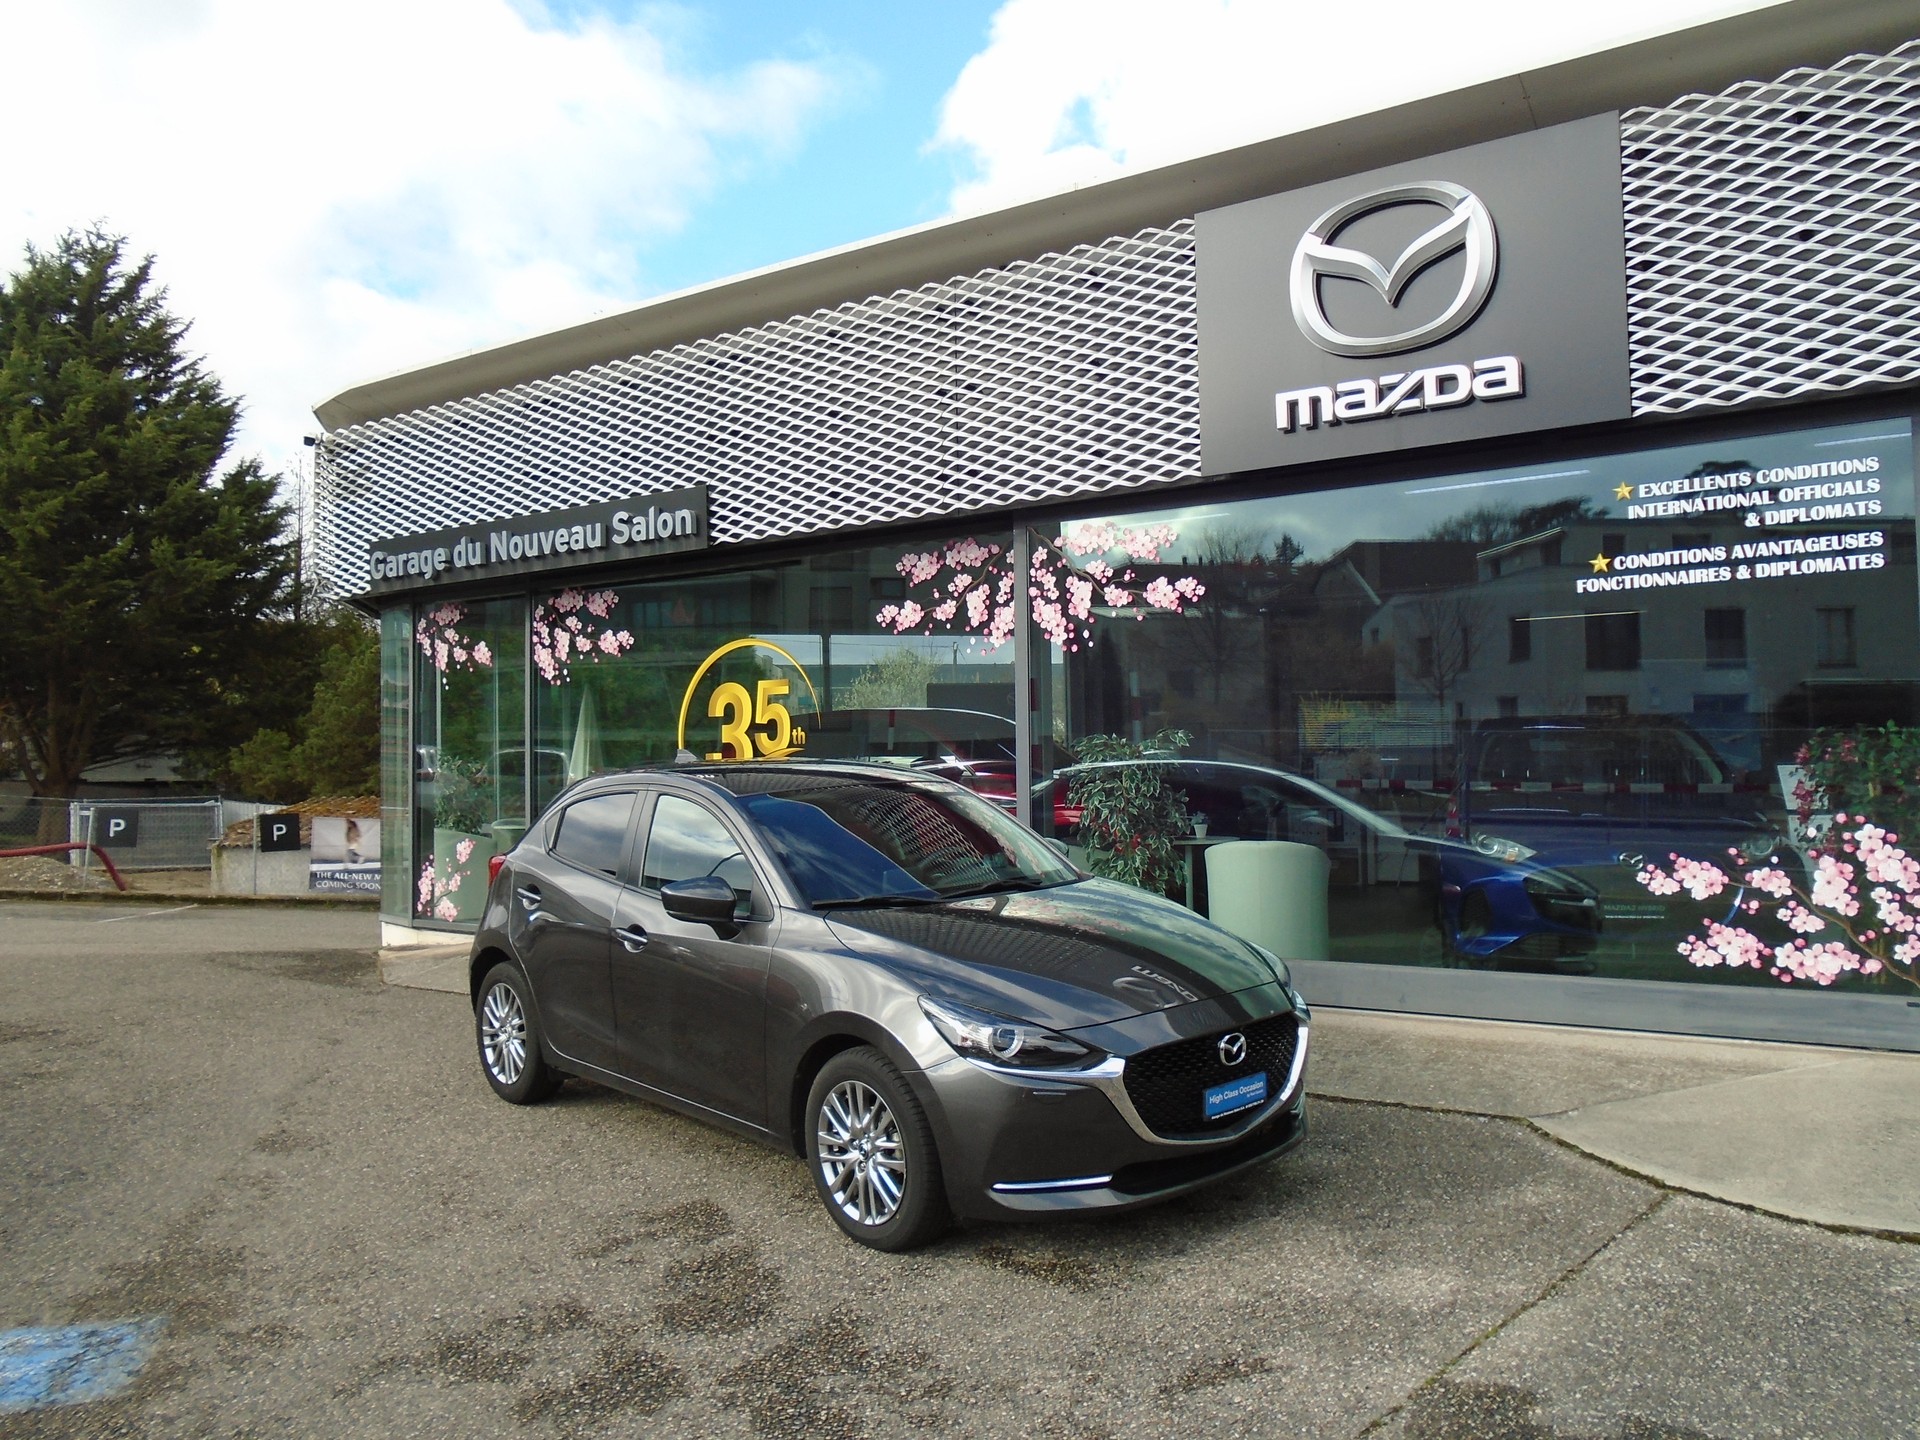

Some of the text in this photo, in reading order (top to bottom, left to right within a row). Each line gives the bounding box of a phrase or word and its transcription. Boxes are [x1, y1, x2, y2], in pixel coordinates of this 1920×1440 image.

[1638, 456, 1880, 498] EXCELLENTS CONDITIONS
[1628, 478, 1881, 520] INTERNATIONAL OFFICIALS
[1745, 500, 1882, 528] & DIPLOMATS
[370, 506, 694, 580] Garage du Nouveau Salon
[1613, 531, 1884, 571] CONDITIONS AVANTAGEUSES
[1576, 553, 1886, 594] FONCTIONNAIRES & DIPLOMATES
[109, 818, 126, 838] P
[272, 824, 287, 842] P
[316, 871, 332, 879] THE
[334, 872, 373, 880] ALL-NEW
[316, 880, 381, 890] COMING SOON
[1209, 1093, 1223, 1104] High
[1223, 1087, 1239, 1100] Class
[1239, 1081, 1264, 1095] Occasion
